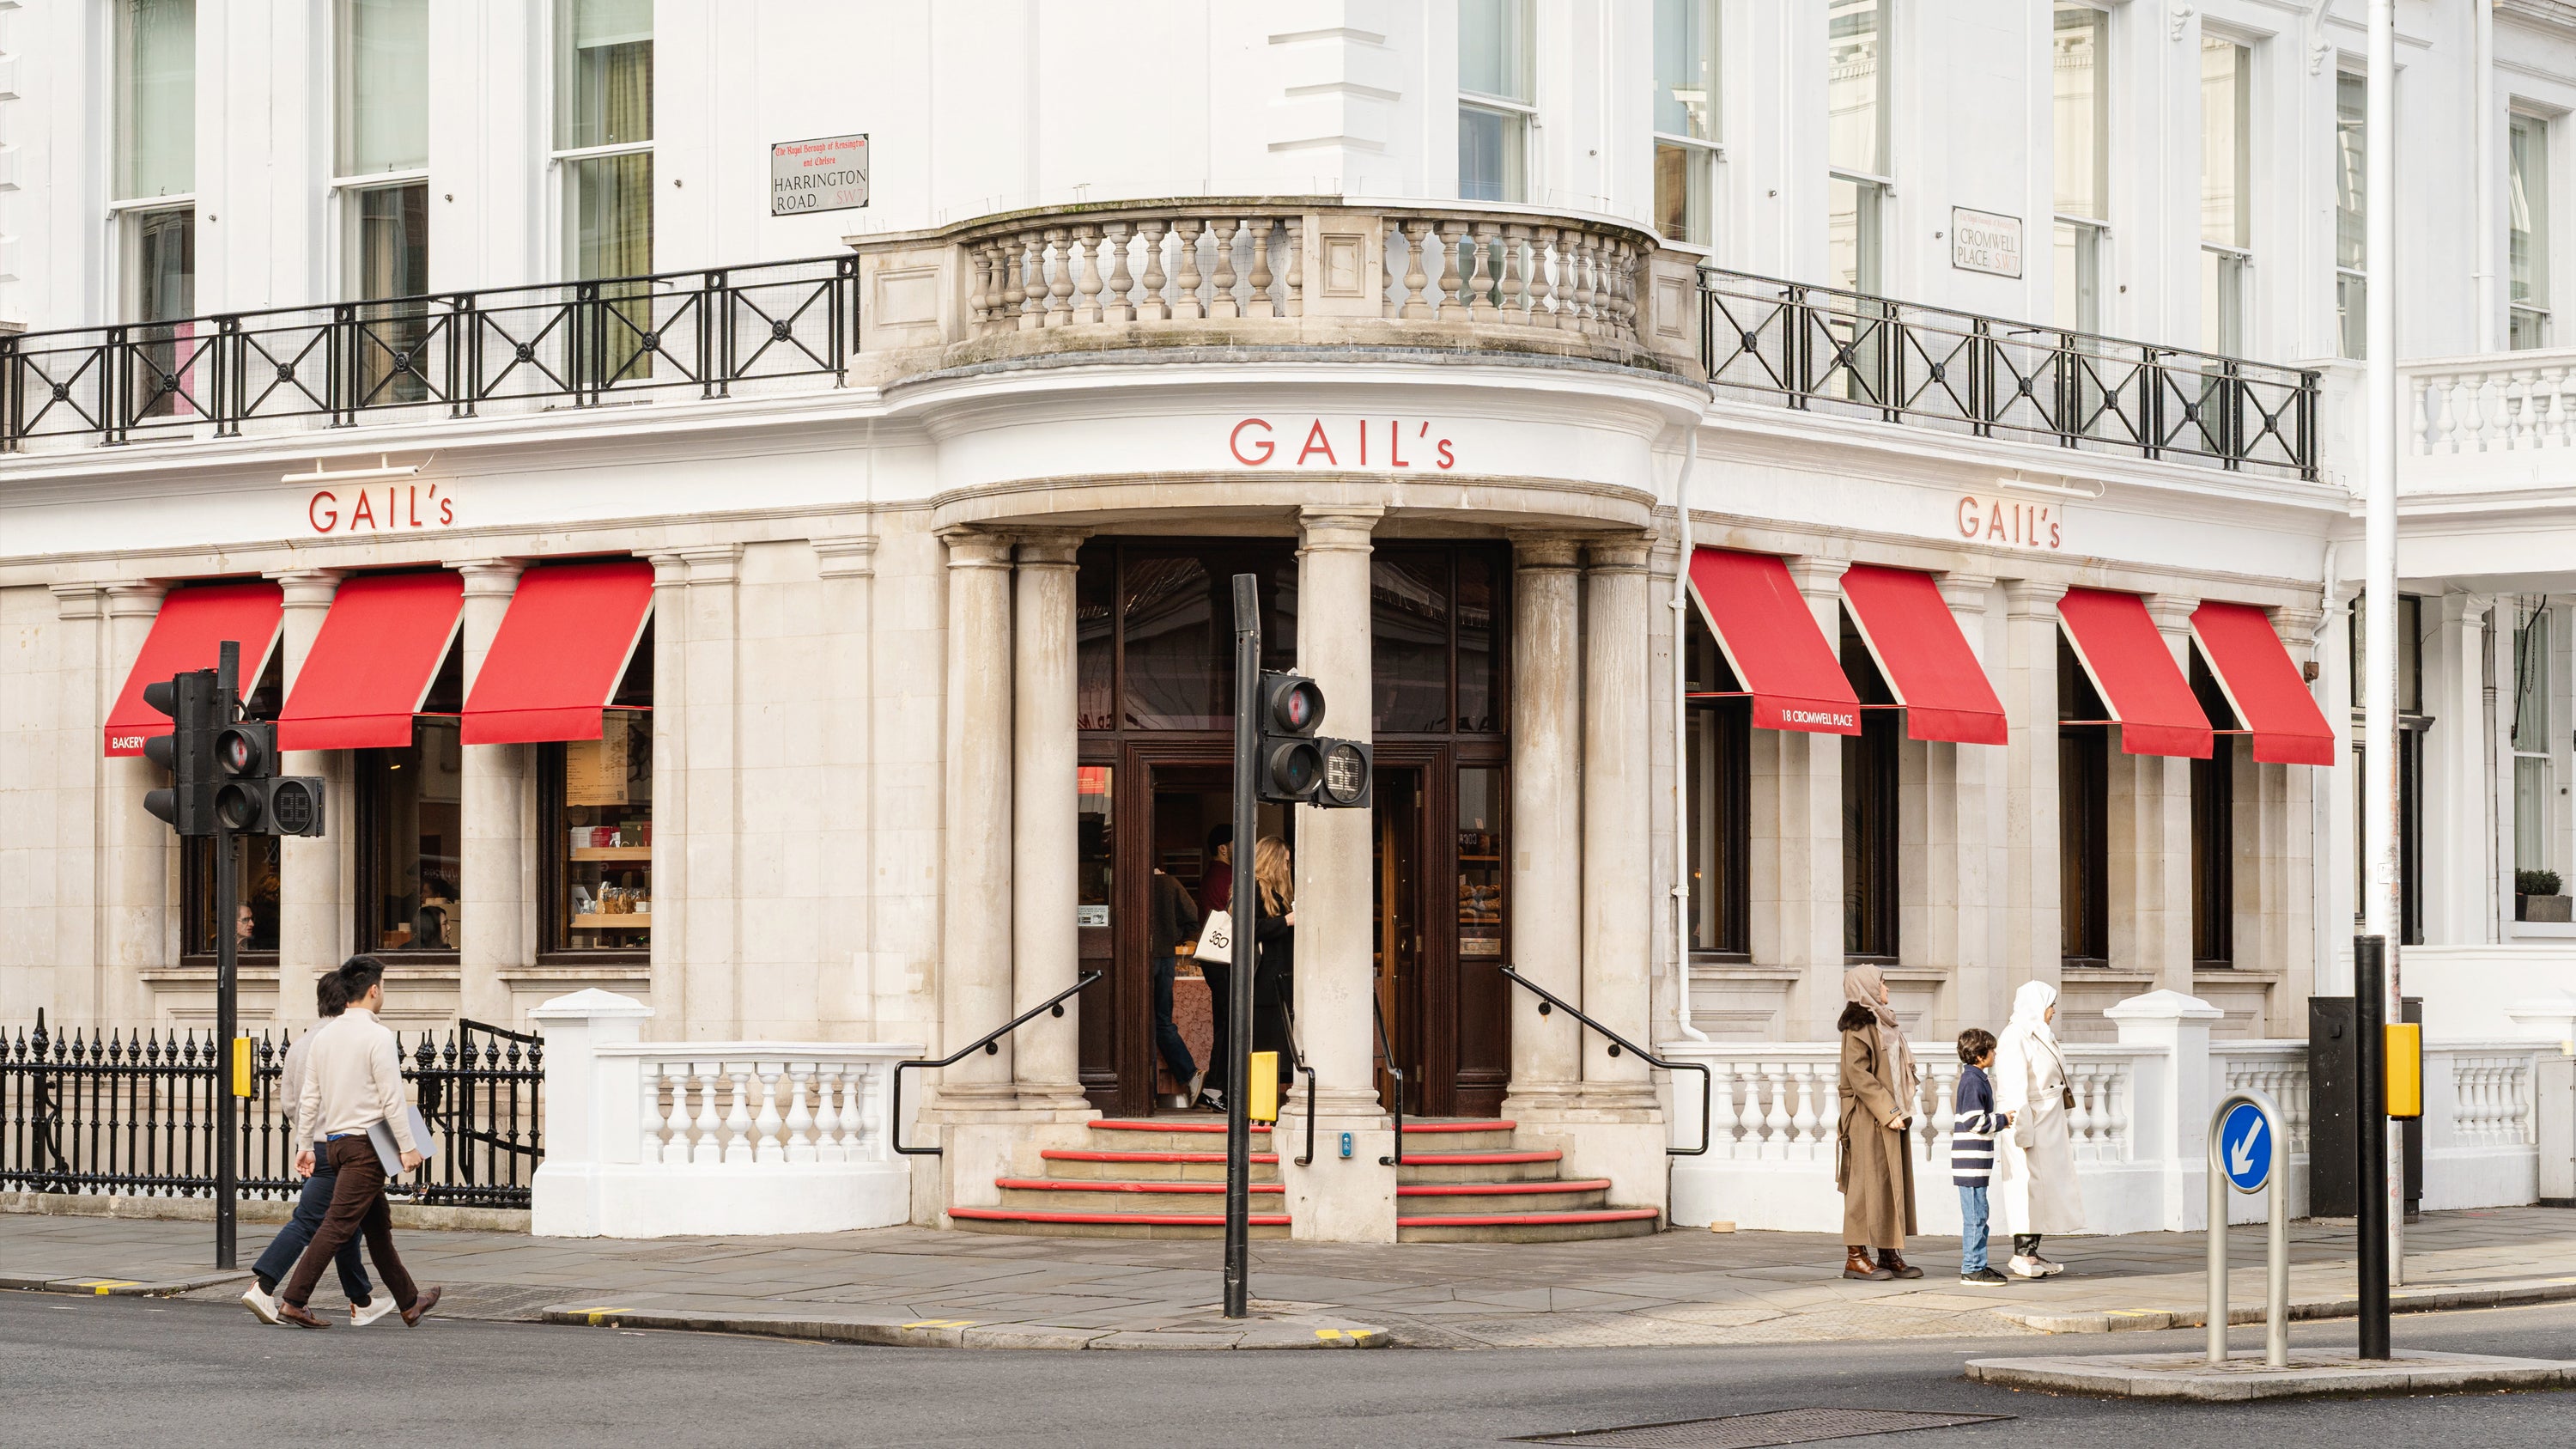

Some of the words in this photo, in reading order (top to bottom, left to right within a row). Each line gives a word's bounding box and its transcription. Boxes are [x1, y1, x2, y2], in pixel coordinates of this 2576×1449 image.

[775, 147, 786, 156] The
[787, 146, 802, 157] Royal
[804, 143, 825, 154] Borough
[835, 140, 865, 150] Kensington
[803, 158, 812, 167] and
[815, 156, 835, 166] Chelsea
[775, 169, 866, 192] HARRINGTON
[1960, 228, 2016, 253] CROMWELL
[1782, 709, 1791, 721] 18
[1793, 710, 1832, 725] CROMWELL
[1833, 714, 1853, 727] PLACE
[112, 736, 144, 749] BAKERY
[1209, 930, 1230, 948] 360
